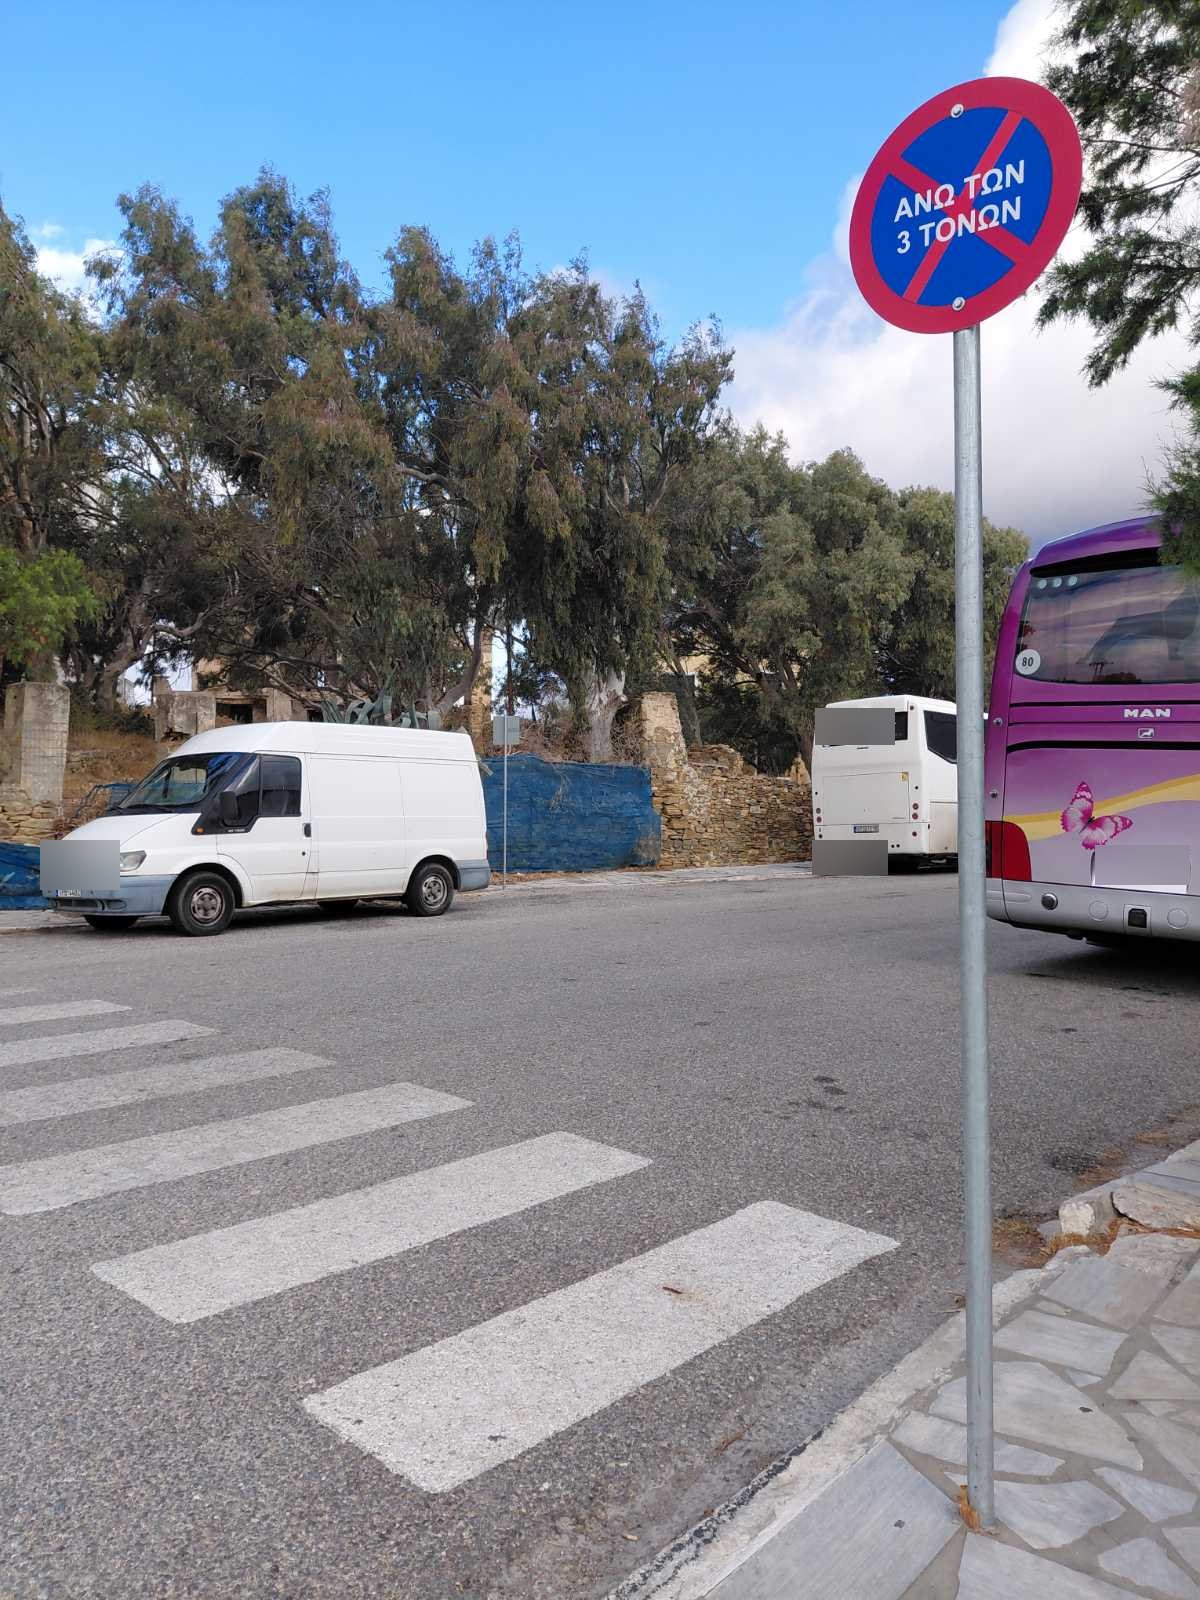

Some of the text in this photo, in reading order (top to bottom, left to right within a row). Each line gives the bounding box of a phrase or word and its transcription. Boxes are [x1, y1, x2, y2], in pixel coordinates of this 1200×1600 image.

[894, 159, 1024, 222] ΑΝΩ ΤΩΝ
[897, 195, 1021, 254] 3 ΤΟΝΩΝ
[1022, 656, 1034, 667] 80
[1123, 708, 1171, 718] MAN
